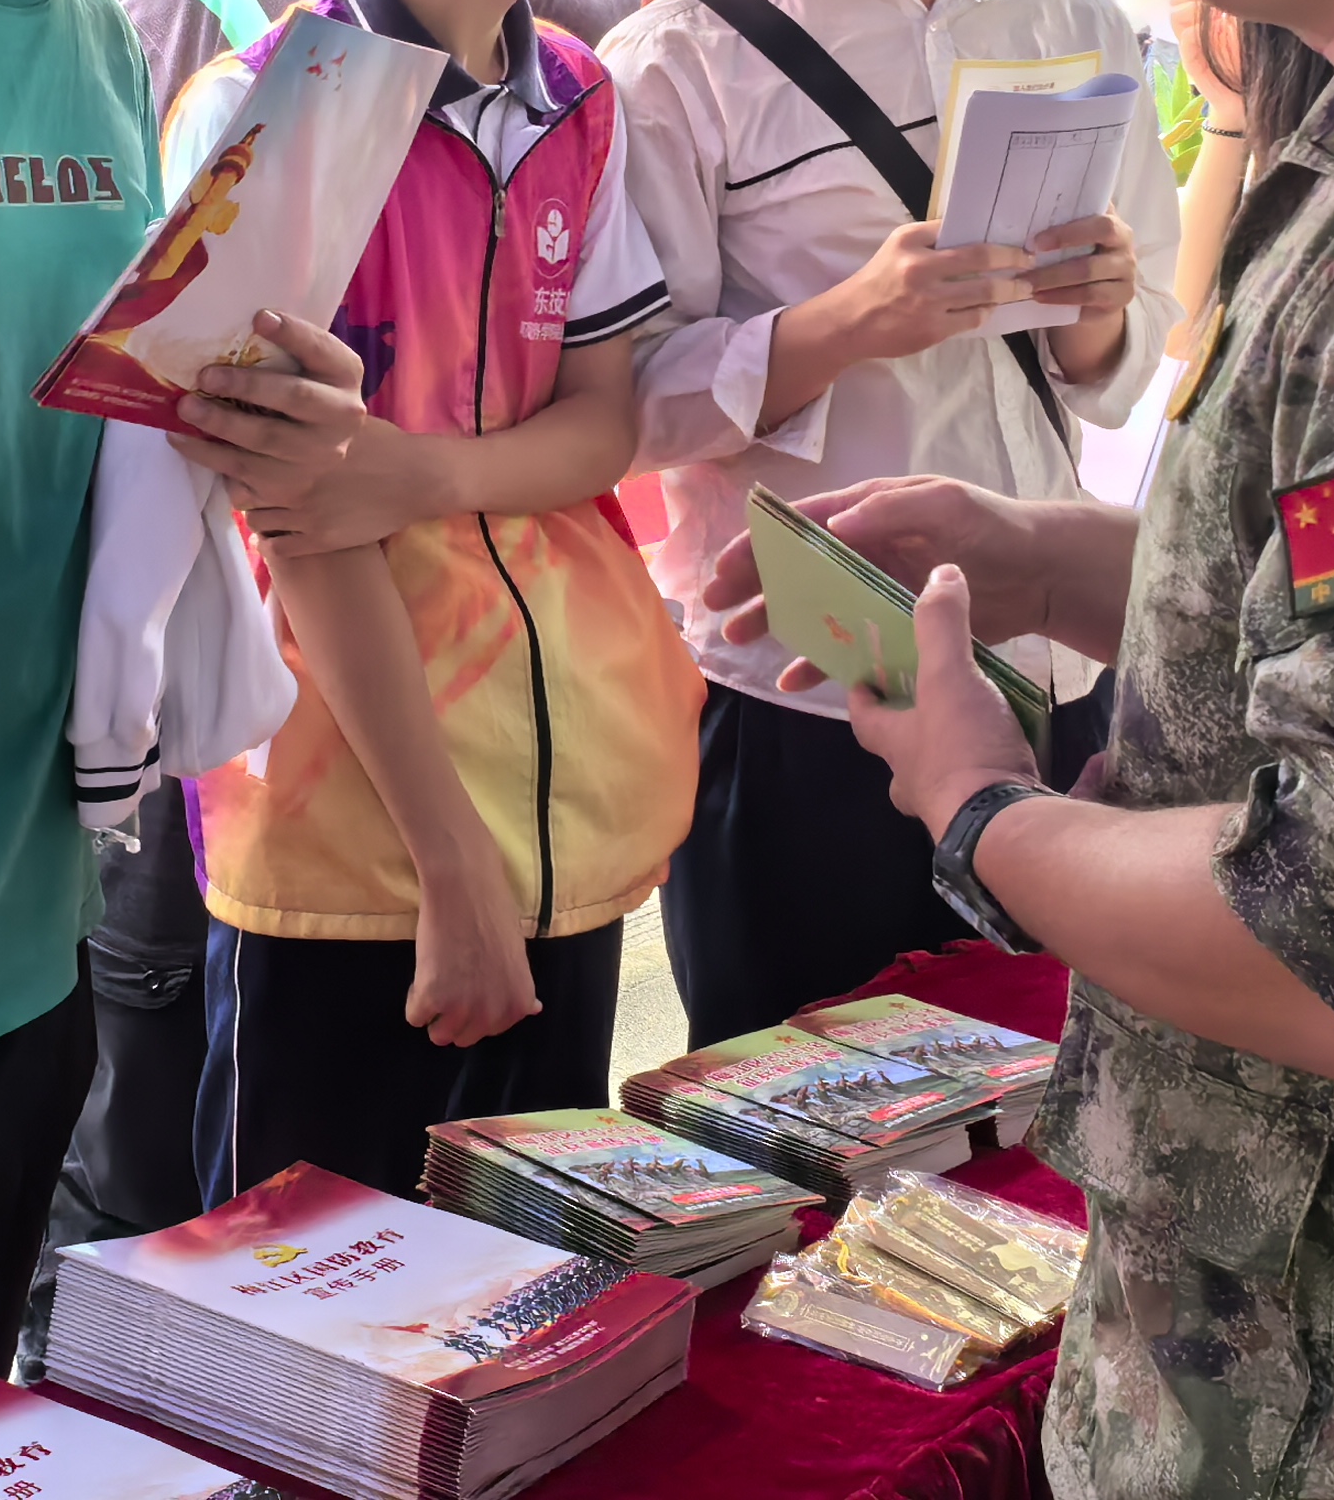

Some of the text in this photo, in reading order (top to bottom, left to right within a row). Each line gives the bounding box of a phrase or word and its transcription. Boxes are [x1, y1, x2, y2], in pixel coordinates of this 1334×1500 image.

[533, 287, 571, 315] 东技
[230, 1228, 404, 1296] 梅江区国防教育
[302, 1257, 406, 1300] 宣传手册
